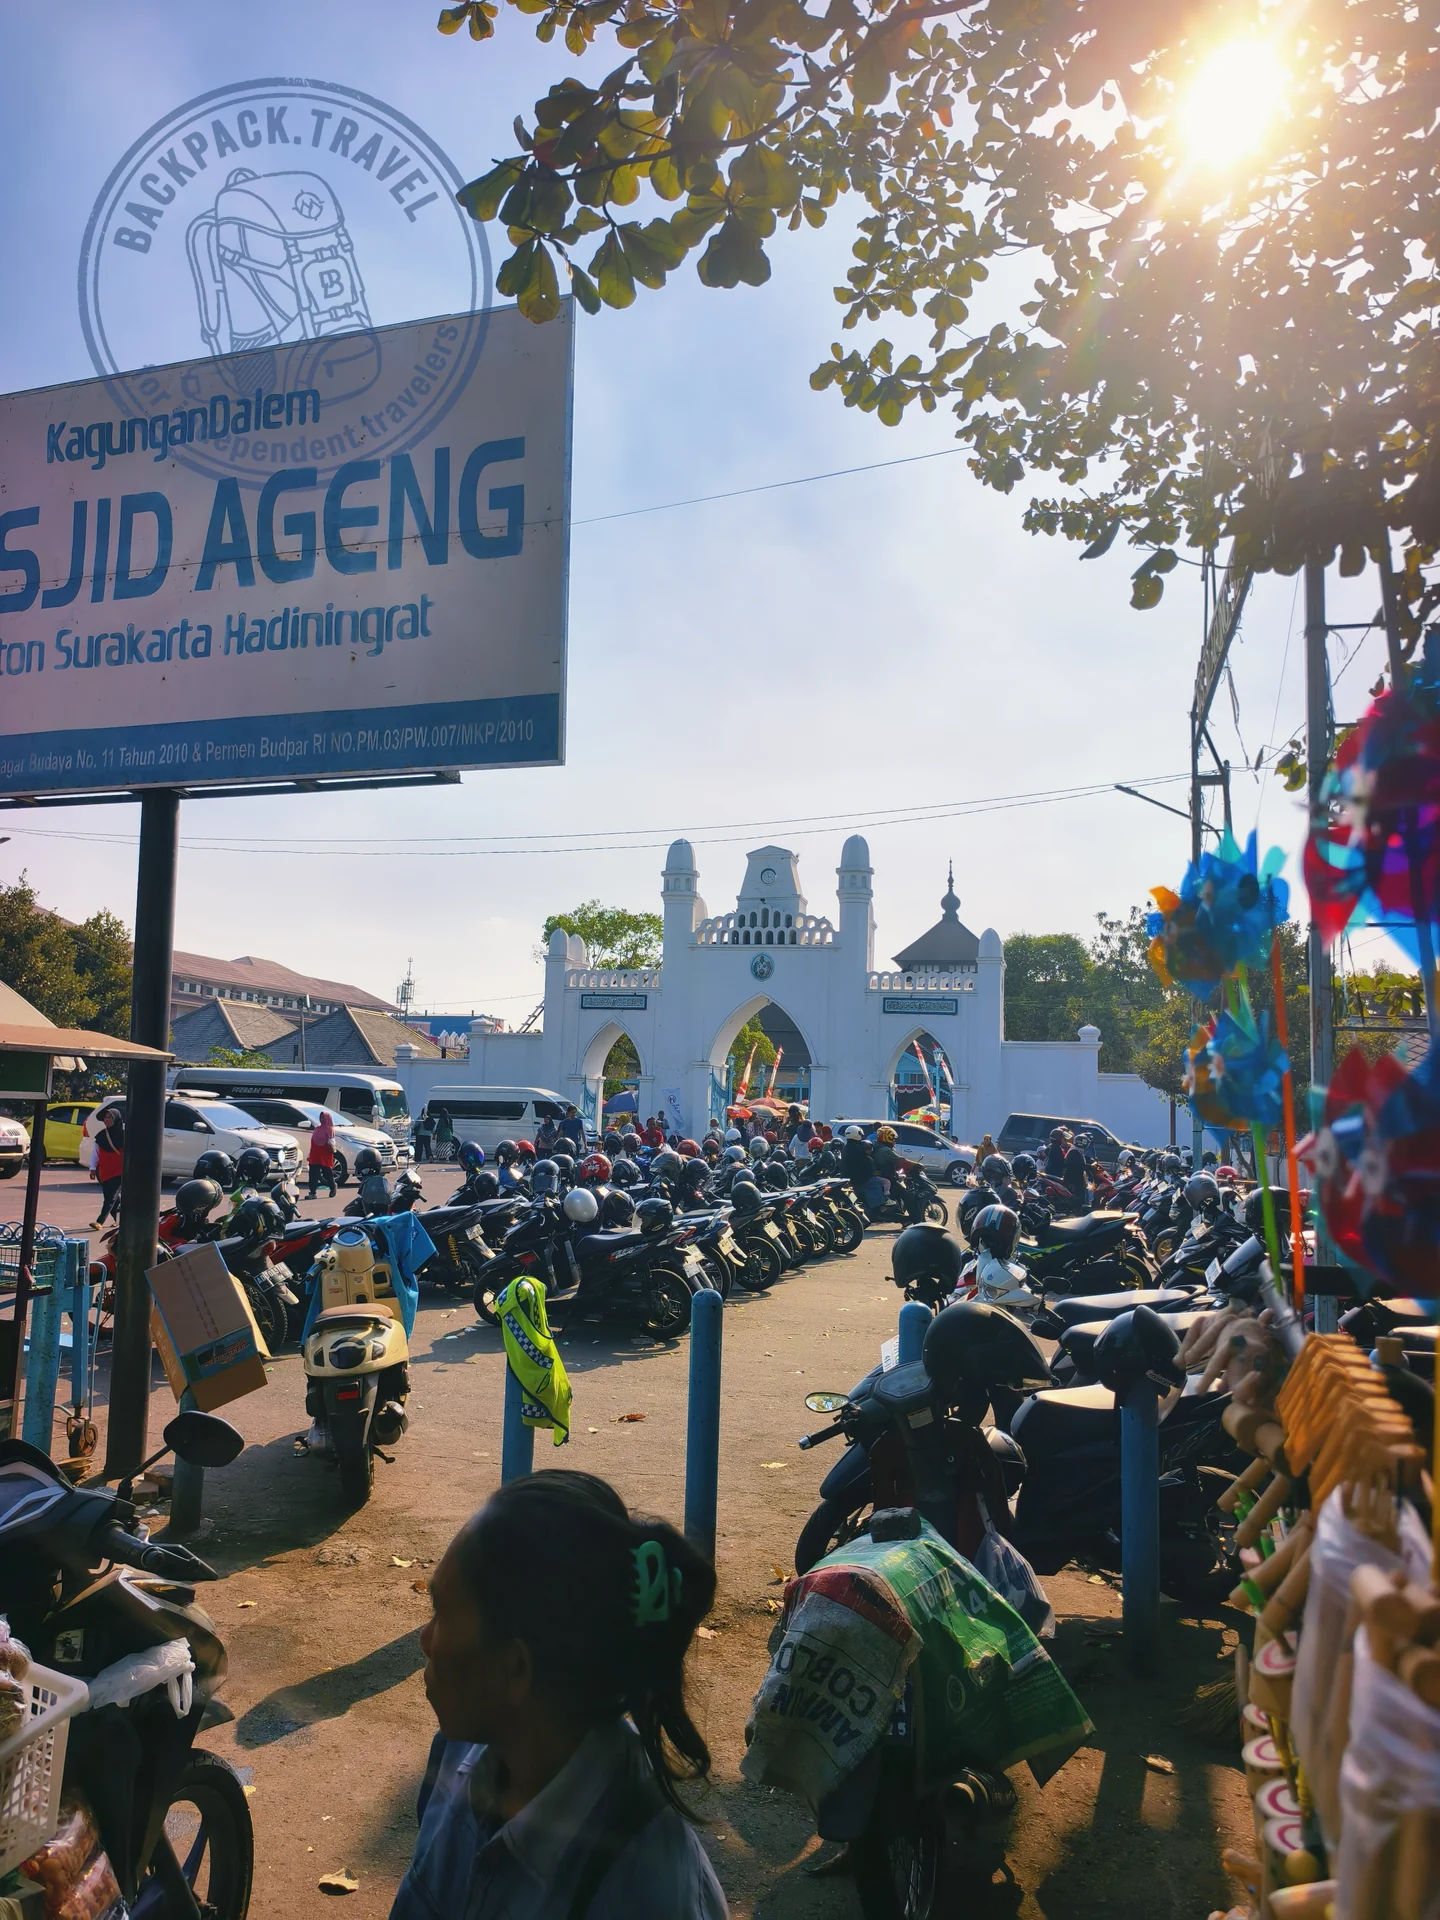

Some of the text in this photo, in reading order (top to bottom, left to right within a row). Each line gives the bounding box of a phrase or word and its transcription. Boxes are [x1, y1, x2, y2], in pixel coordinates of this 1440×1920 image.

[47, 387, 321, 471] KagunganDalem
[194, 436, 525, 592] AGENG
[54, 618, 213, 670] Surakarta
[224, 593, 435, 657] Hadiningrat
[29, 753, 72, 775] Budaya
[76, 749, 97, 769] No.
[102, 747, 114, 768] 11
[119, 747, 155, 767] Tahun
[159, 743, 188, 764] 2010
[192, 744, 202, 763] &
[206, 740, 256, 762] Permen
[260, 736, 309, 761] Budpar
[313, 733, 326, 755] RI
